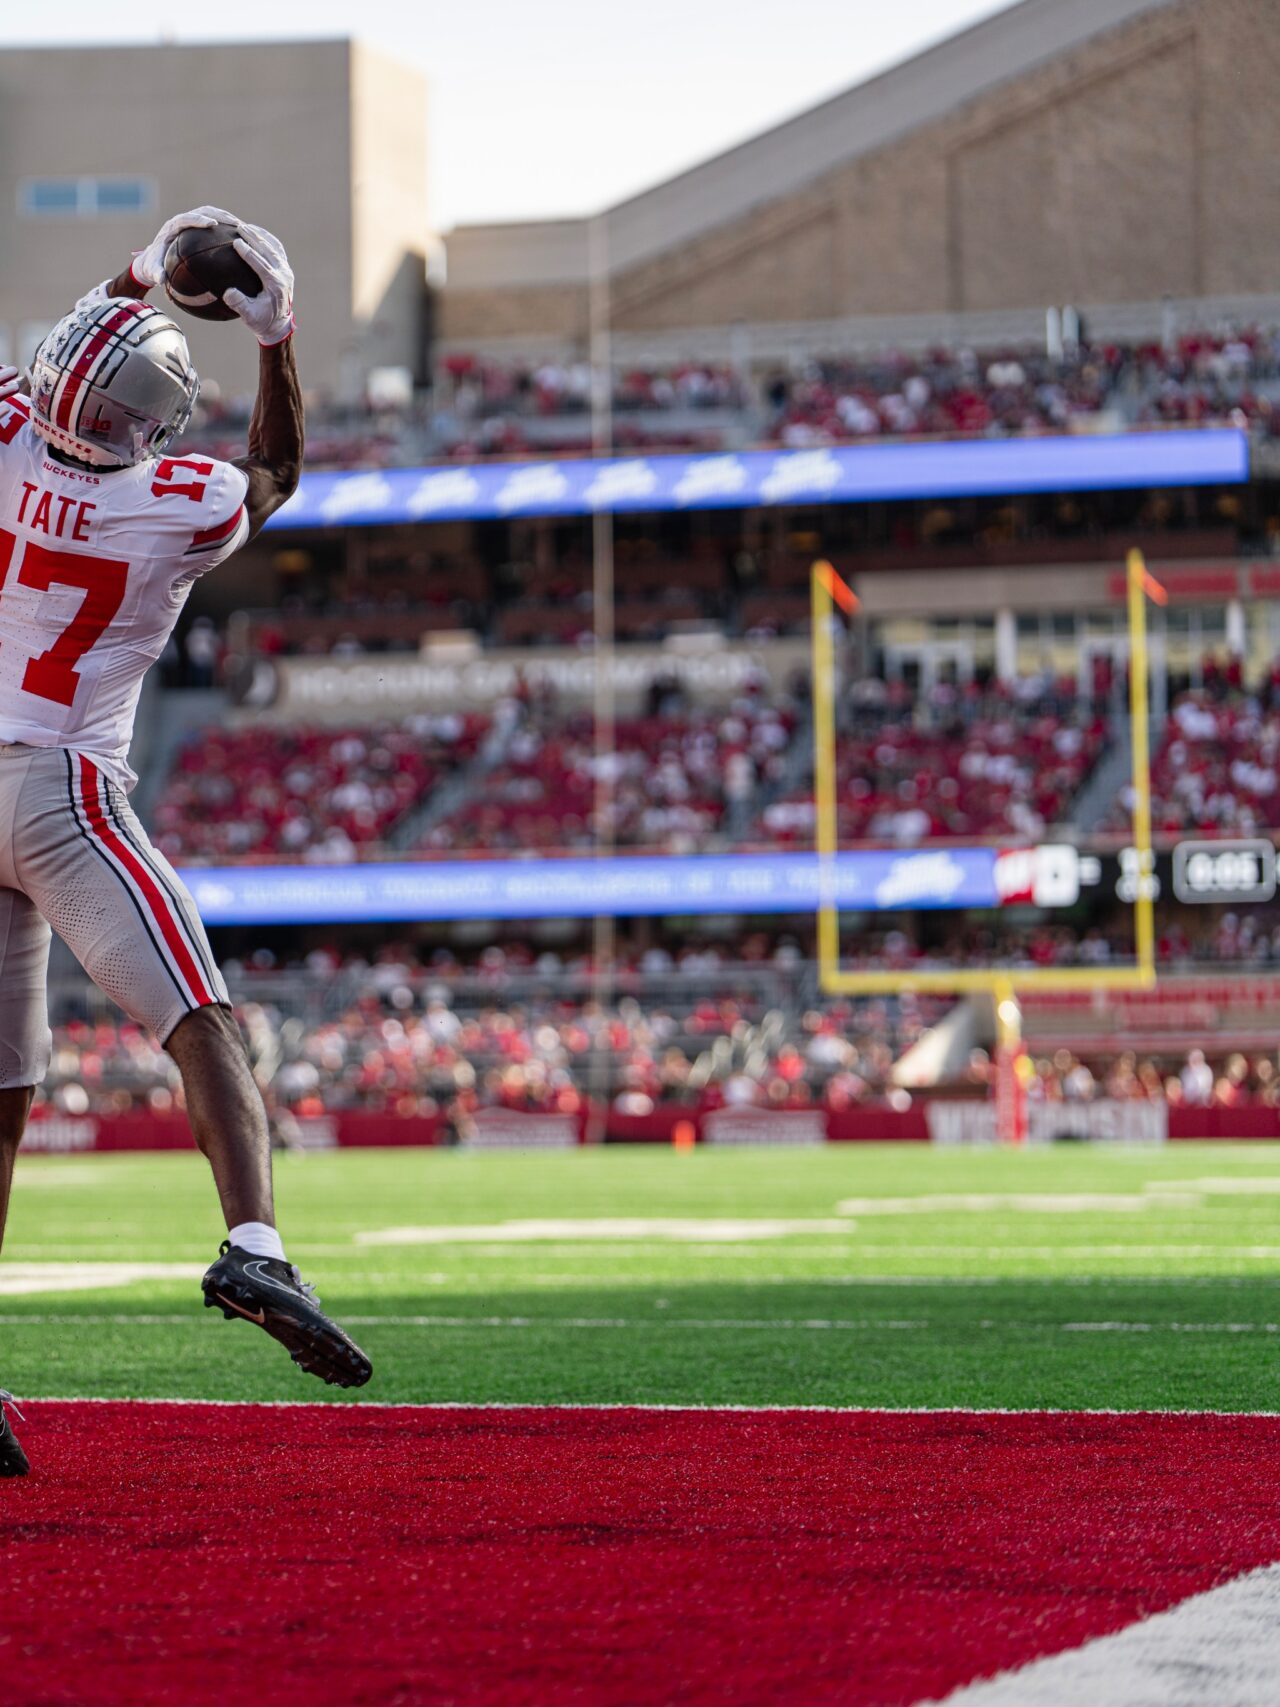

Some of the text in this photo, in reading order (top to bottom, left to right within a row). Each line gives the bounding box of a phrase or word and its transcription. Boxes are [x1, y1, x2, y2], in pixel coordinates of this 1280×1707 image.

[33, 417, 93, 454] BUCKEYES
[43, 461, 101, 485] BUCKEYES
[151, 458, 214, 503] 17
[18, 481, 97, 542] TATE
